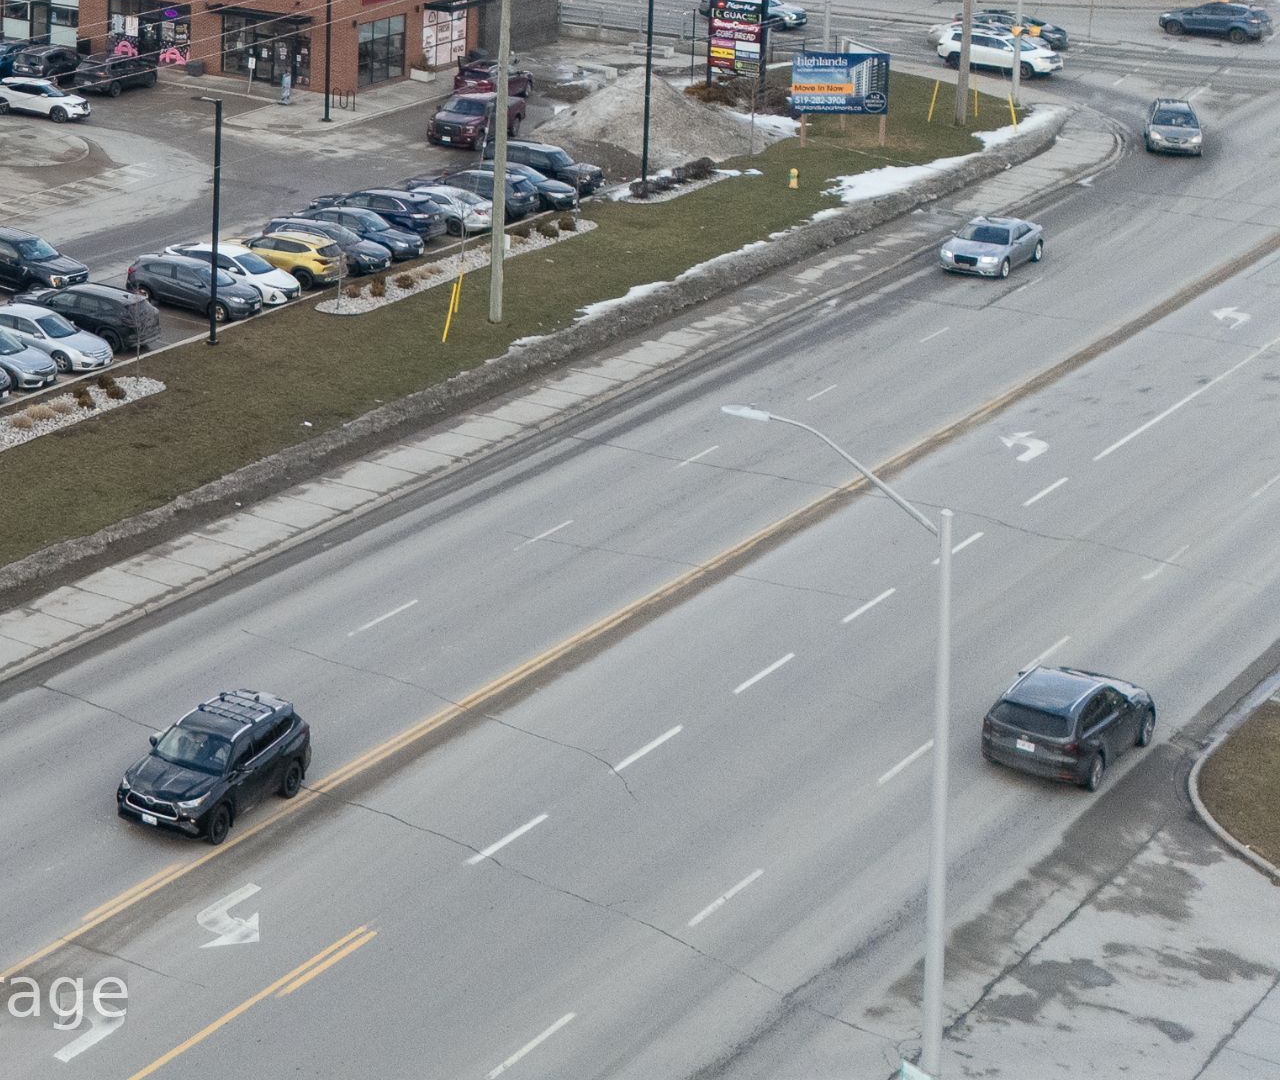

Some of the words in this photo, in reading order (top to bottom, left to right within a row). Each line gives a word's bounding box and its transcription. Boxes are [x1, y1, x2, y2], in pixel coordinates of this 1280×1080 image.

[723, 11, 748, 20] GUAC
[716, 29, 733, 38] COBS
[734, 31, 756, 41] BREAD
[796, 56, 848, 67] highlands
